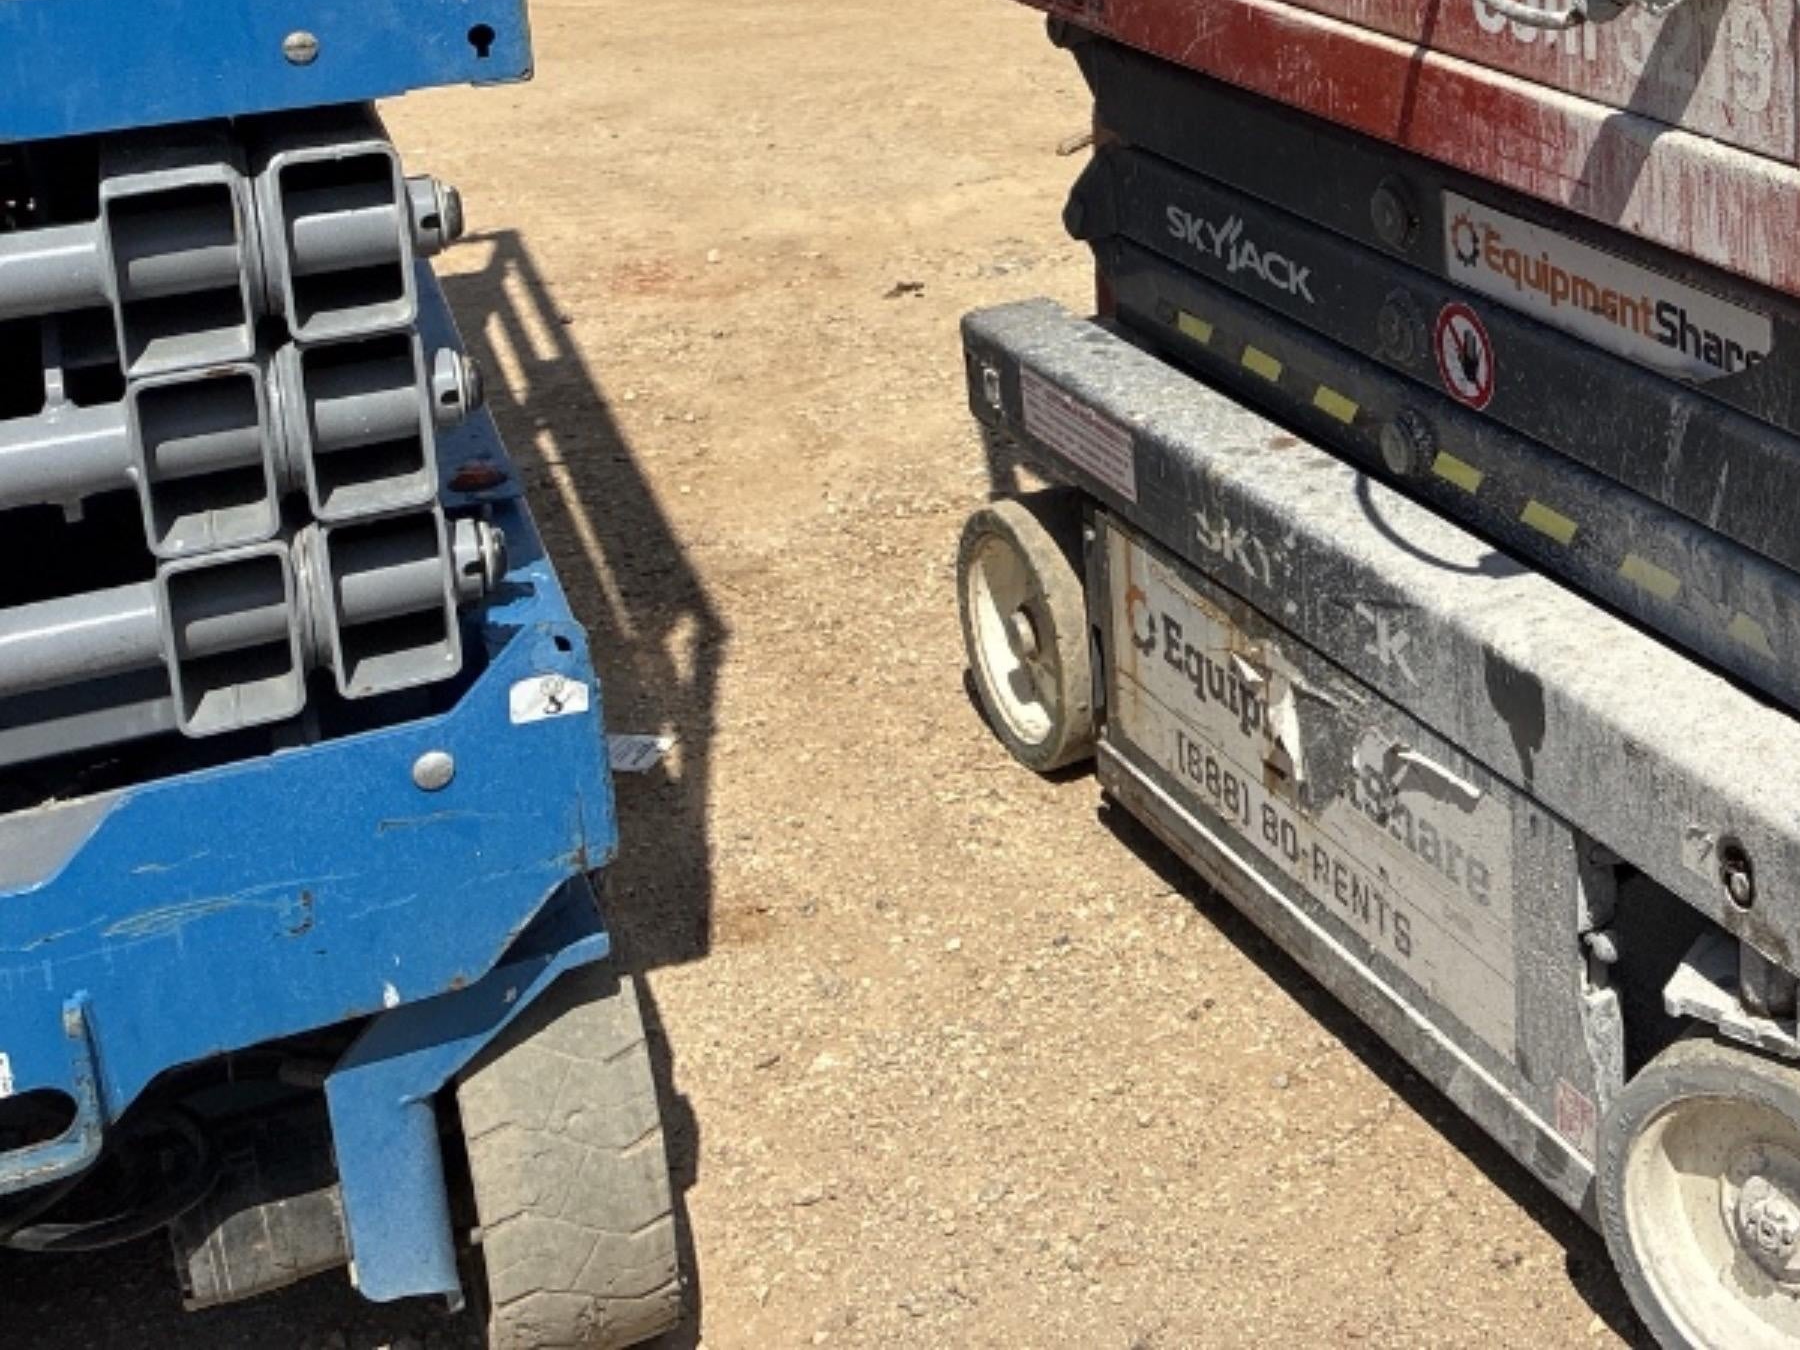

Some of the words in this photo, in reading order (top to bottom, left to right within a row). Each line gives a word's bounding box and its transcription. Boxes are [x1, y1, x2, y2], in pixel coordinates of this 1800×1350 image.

[1166, 205, 1315, 304] SKYJACK
[1176, 730, 1251, 827] (888)
[1261, 801, 1412, 958] 80-RENTS
